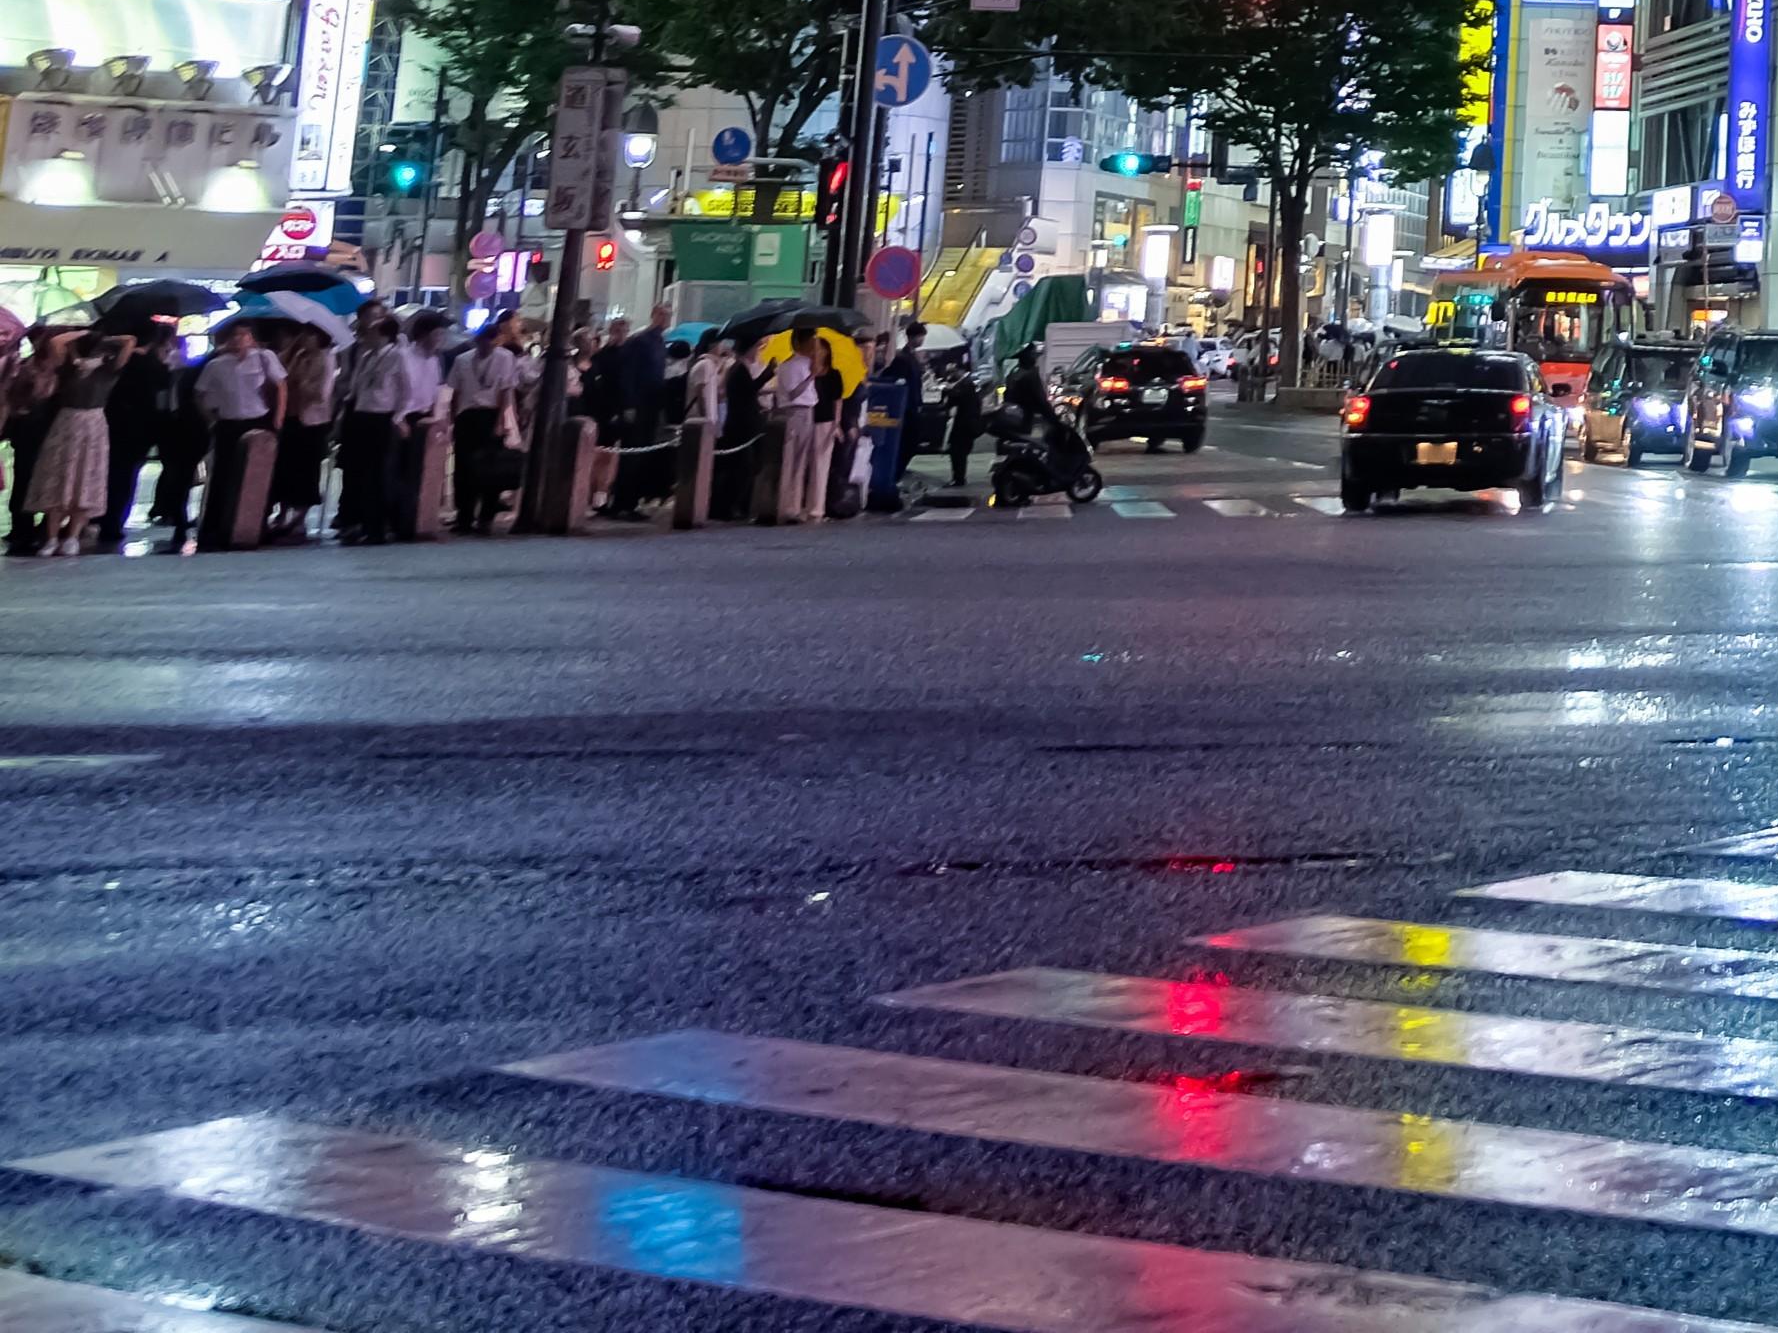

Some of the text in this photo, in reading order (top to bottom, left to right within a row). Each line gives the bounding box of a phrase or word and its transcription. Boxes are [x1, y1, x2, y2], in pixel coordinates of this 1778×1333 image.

[1524, 197, 1650, 247] グルメタウン
